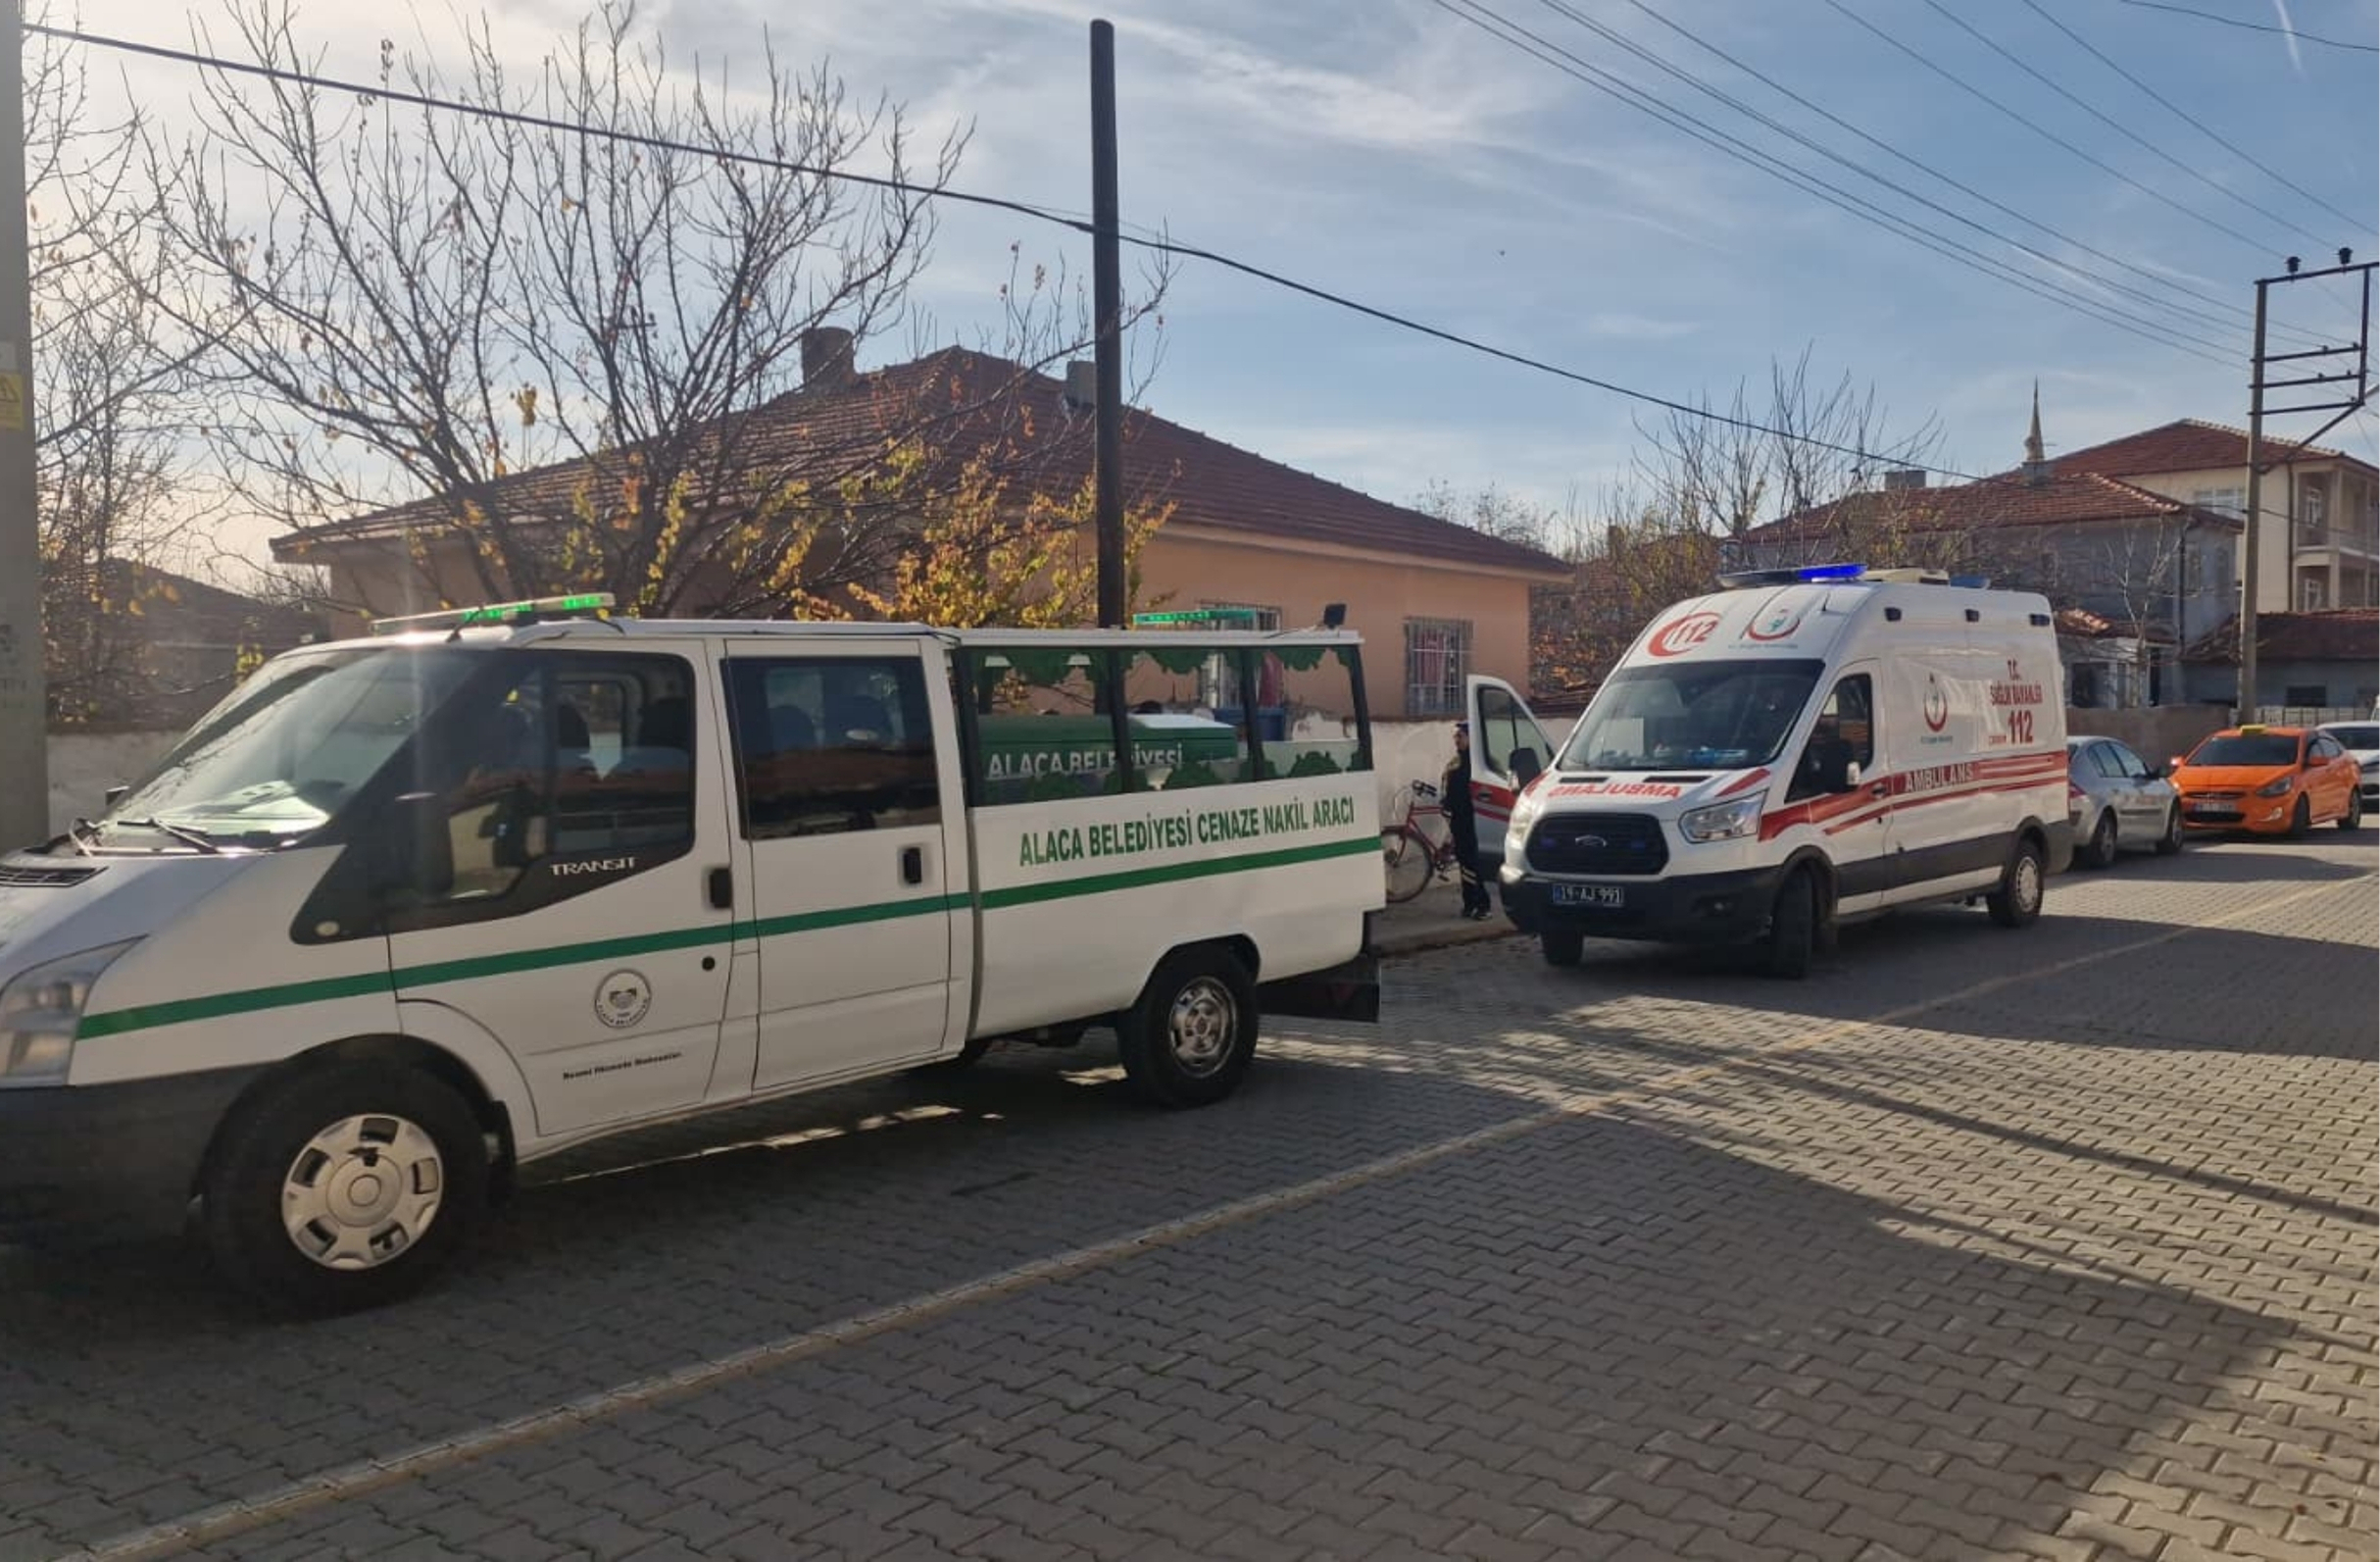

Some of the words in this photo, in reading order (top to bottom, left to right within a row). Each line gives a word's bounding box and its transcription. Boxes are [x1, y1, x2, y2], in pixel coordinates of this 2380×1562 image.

[1670, 620, 1718, 645] 112
[2008, 710, 2033, 744] 112
[1905, 762, 1974, 793] AMBULANS
[1020, 829, 1084, 866] ALACA
[1089, 808, 1193, 857] BELEDİYESİ
[1197, 807, 1261, 844] CENAZE
[1263, 796, 1309, 834] NAKİL
[1313, 795, 1355, 829] ARACI
[550, 856, 635, 876] TRANSIT
